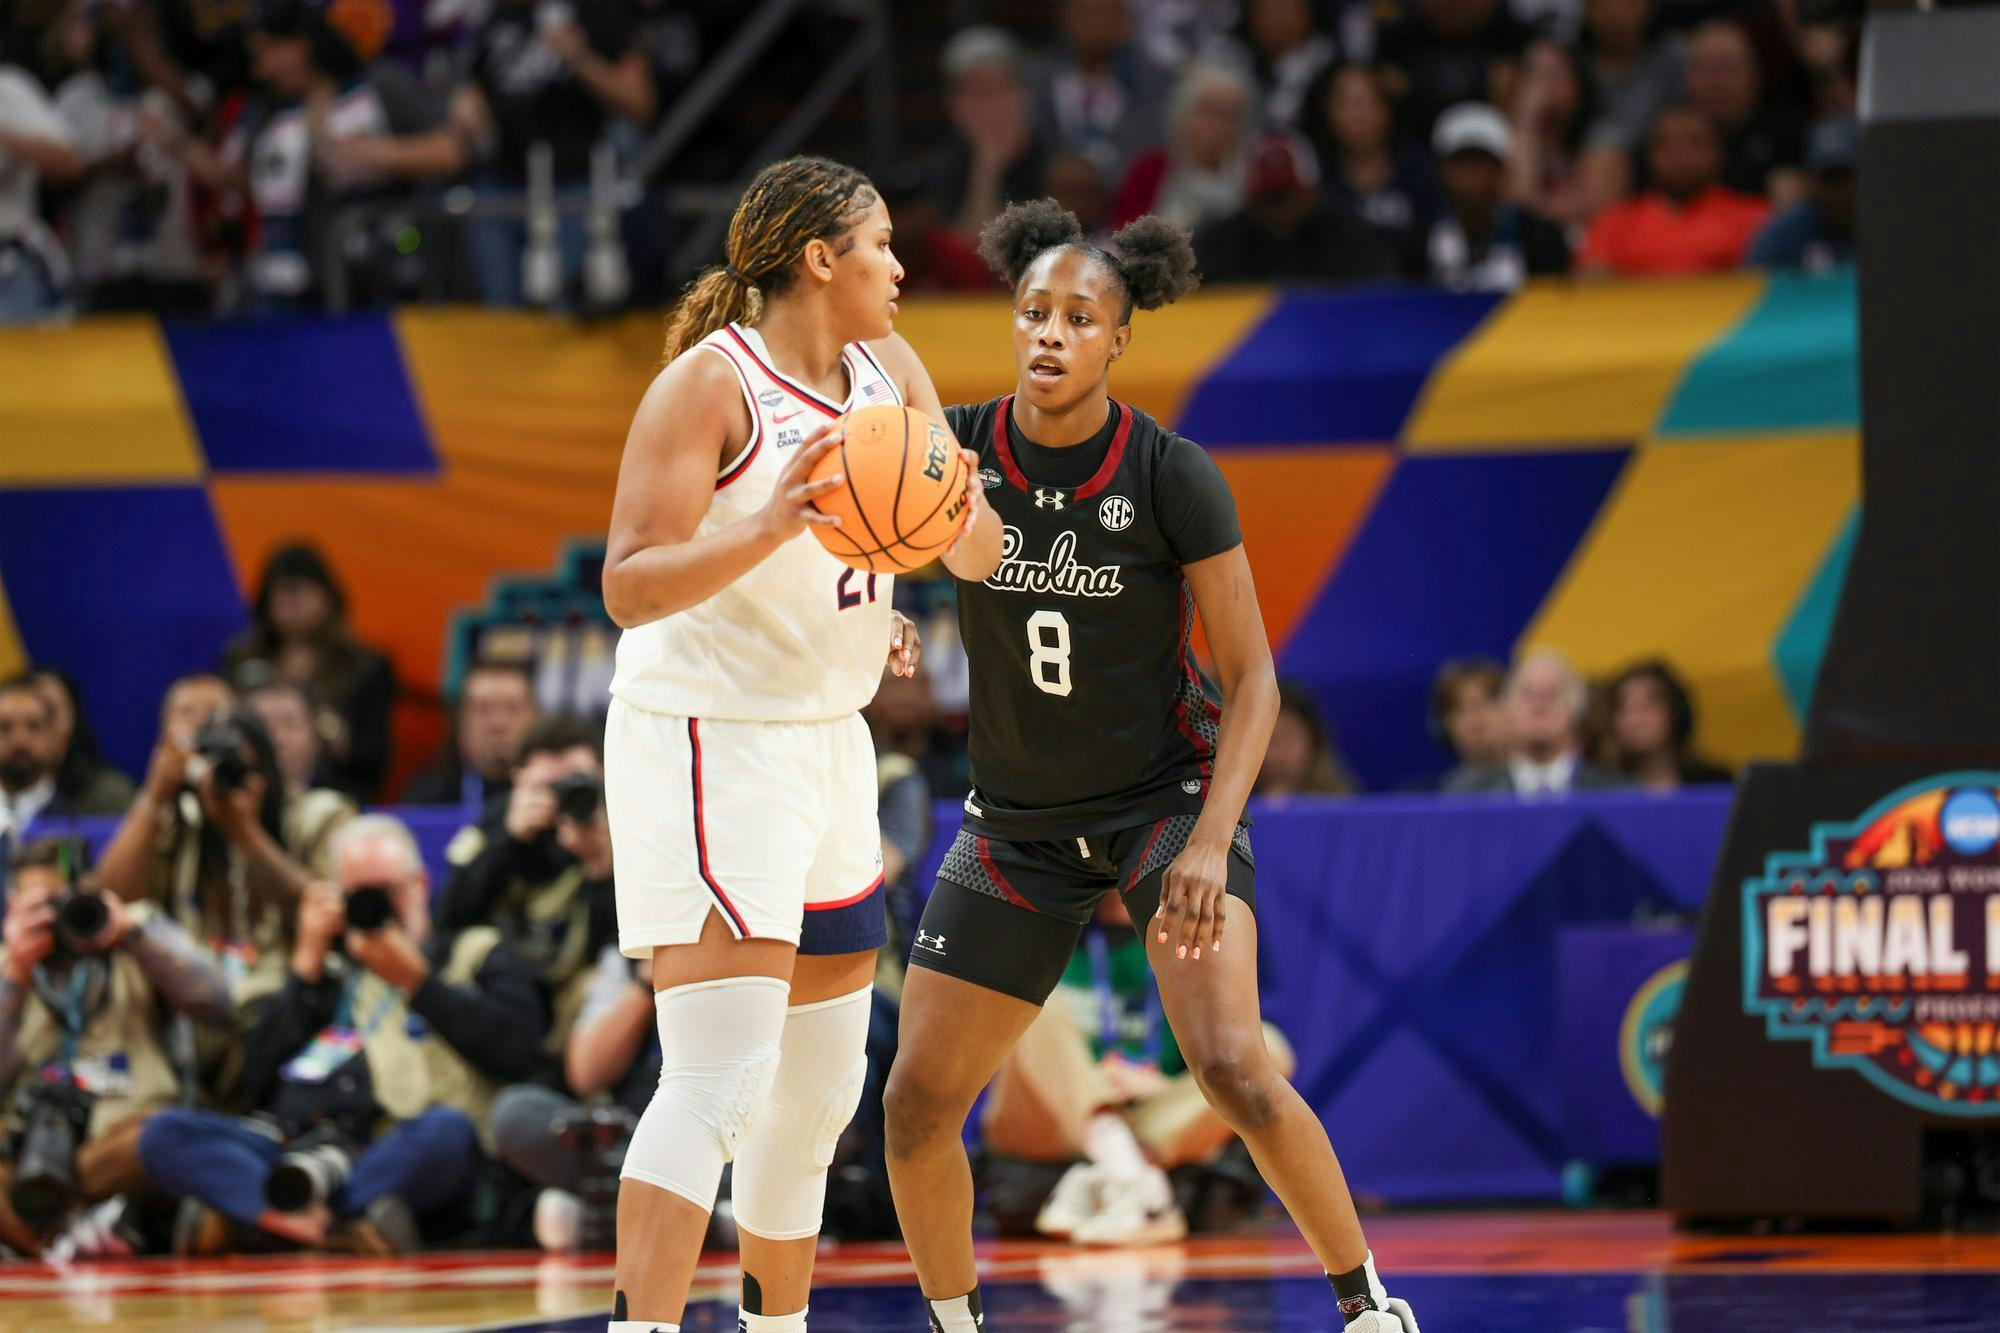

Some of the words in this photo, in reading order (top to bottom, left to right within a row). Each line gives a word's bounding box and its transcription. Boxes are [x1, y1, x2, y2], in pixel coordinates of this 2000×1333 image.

[1102, 498, 1131, 529] SEC
[1026, 610, 1073, 697] 8
[1767, 895, 1969, 985] FINAL
